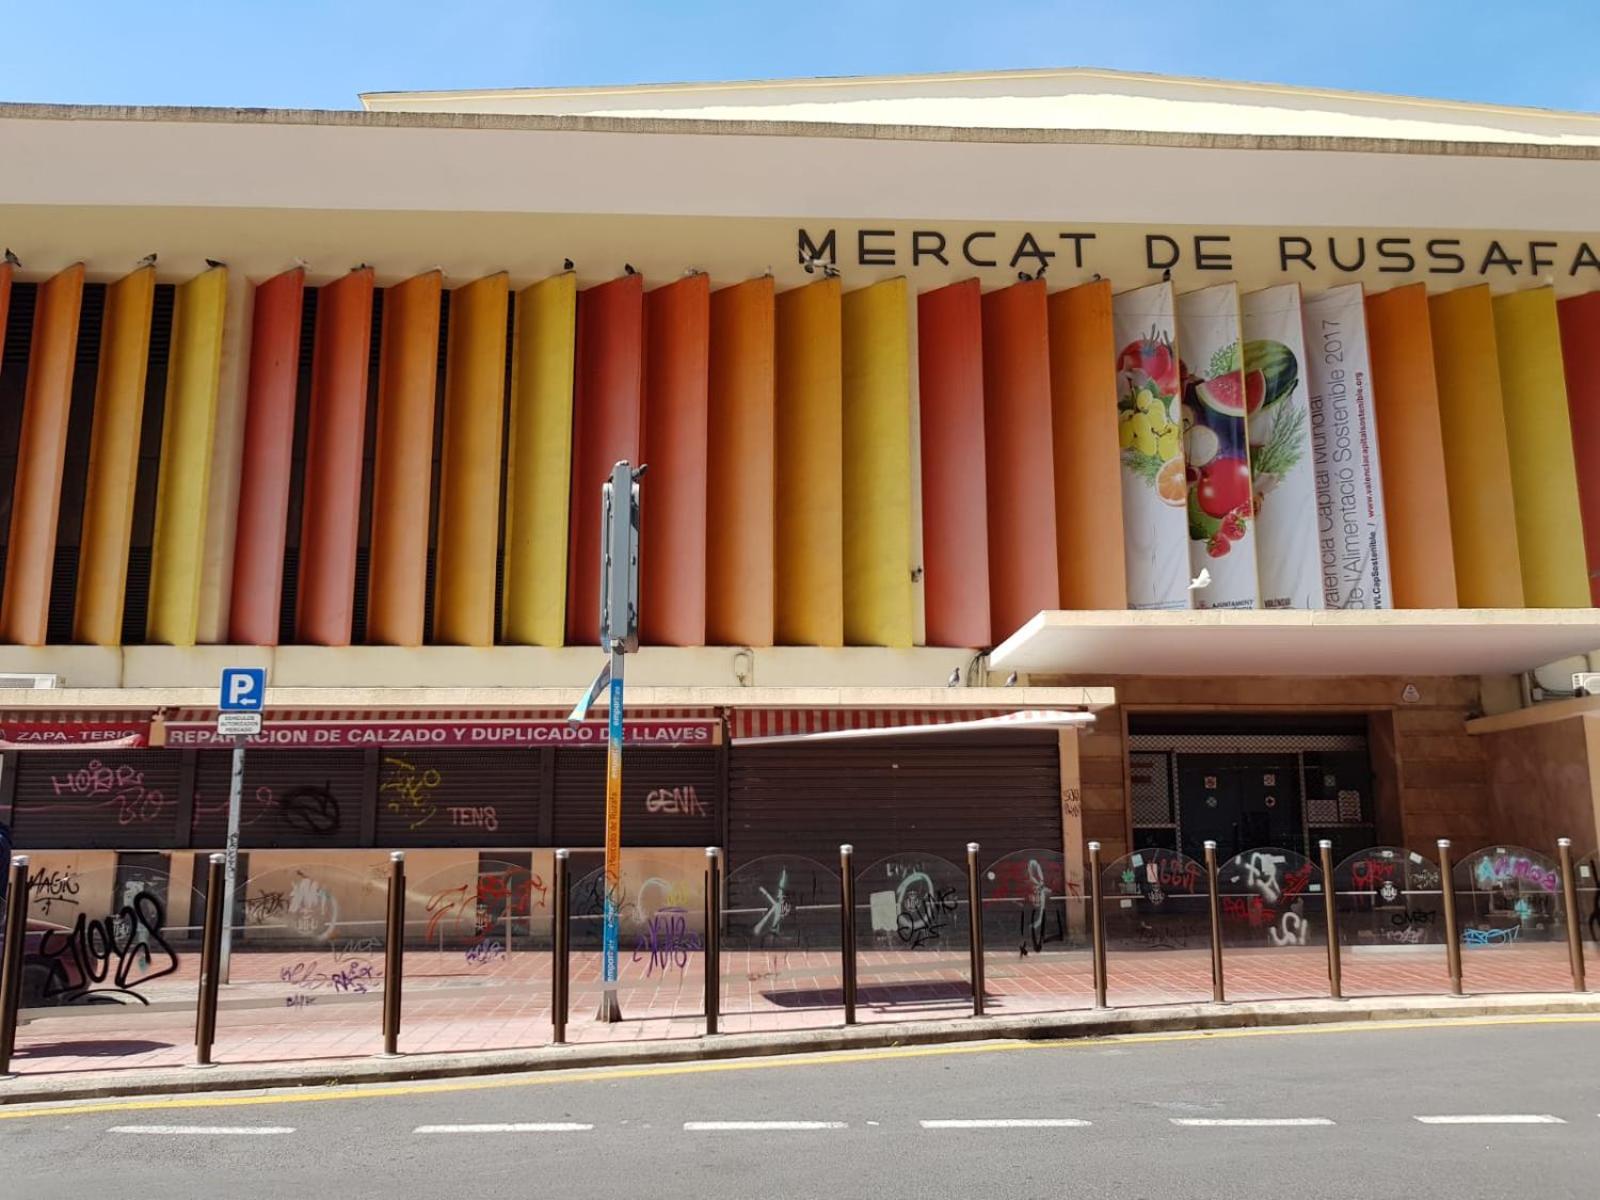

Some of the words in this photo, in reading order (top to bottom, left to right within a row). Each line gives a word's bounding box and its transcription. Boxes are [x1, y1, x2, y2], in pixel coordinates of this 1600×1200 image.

[798, 229, 1097, 268] MERCAT
[1145, 234, 1233, 270] DE
[1278, 236, 1600, 276] RUSSAFA
[1322, 319, 1343, 364] 2017
[1328, 369, 1353, 464] Sostenible
[229, 673, 254, 704] P
[314, 729, 342, 743] DE
[347, 728, 447, 742] CALZADO
[453, 727, 467, 741] Y
[471, 727, 593, 741] DUPLICADO
[632, 726, 708, 741] LLAVES
